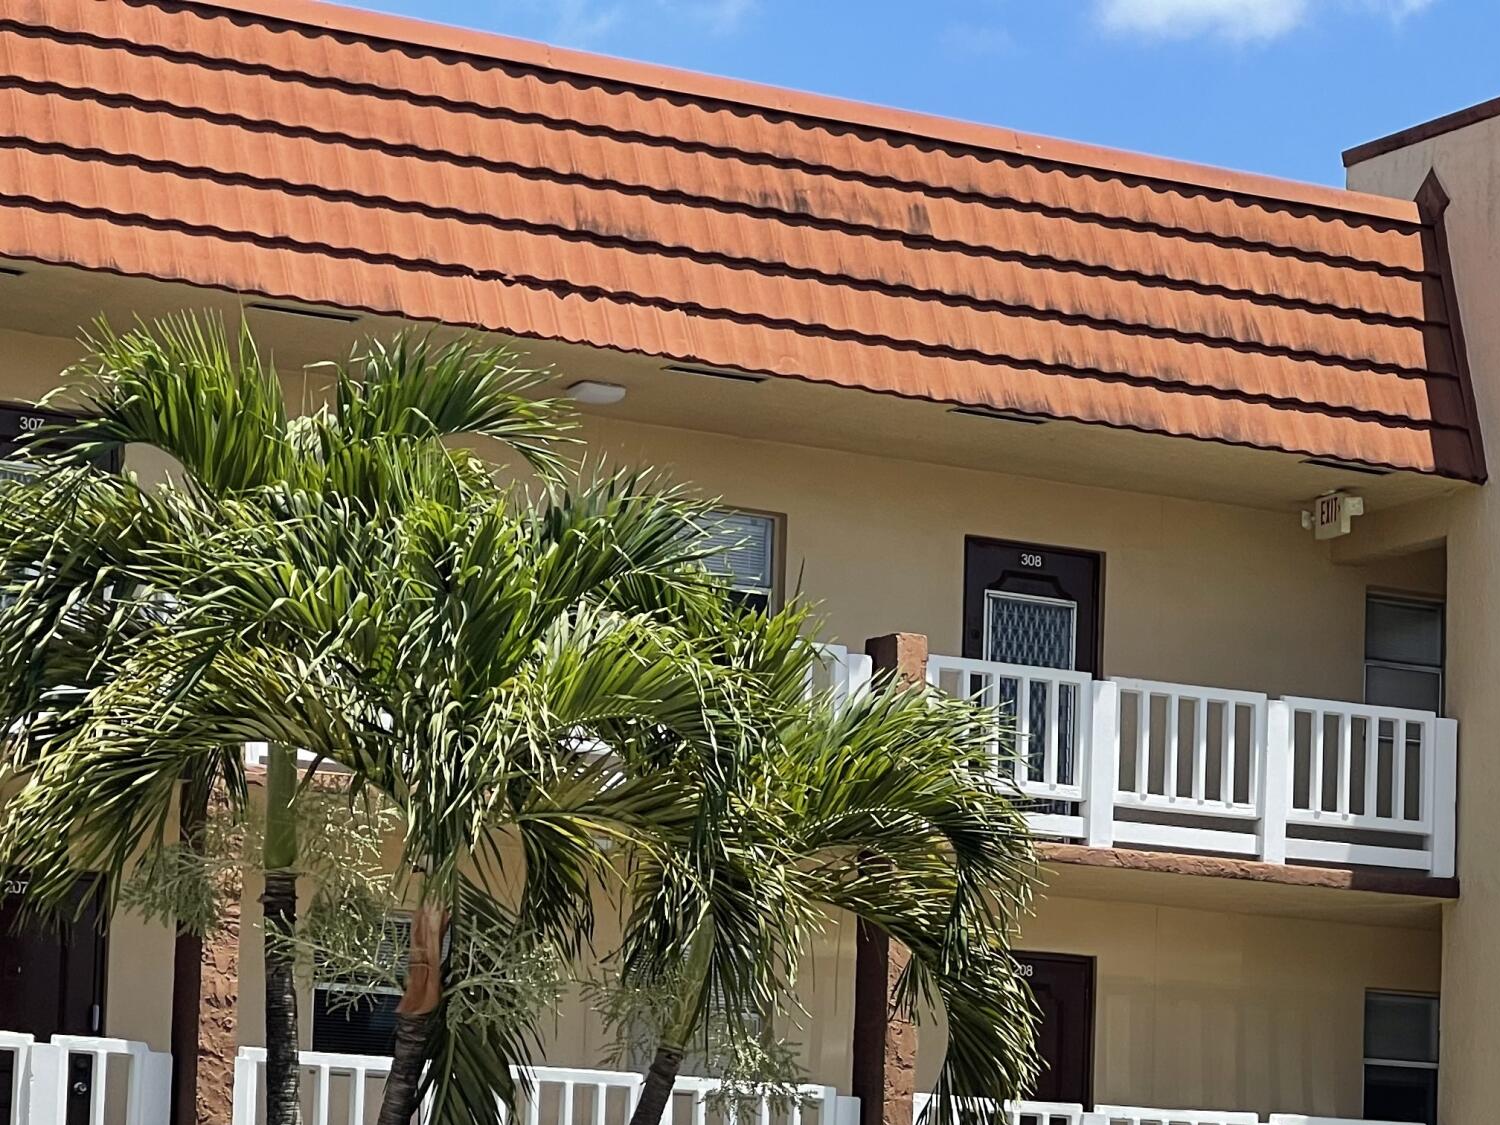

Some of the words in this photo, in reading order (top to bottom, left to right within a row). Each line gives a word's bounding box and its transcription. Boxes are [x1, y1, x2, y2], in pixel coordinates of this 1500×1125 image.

[20, 416, 45, 430] 307
[1321, 497, 1338, 526] EXIT
[1021, 553, 1041, 567] 308
[4, 880, 29, 894] 207
